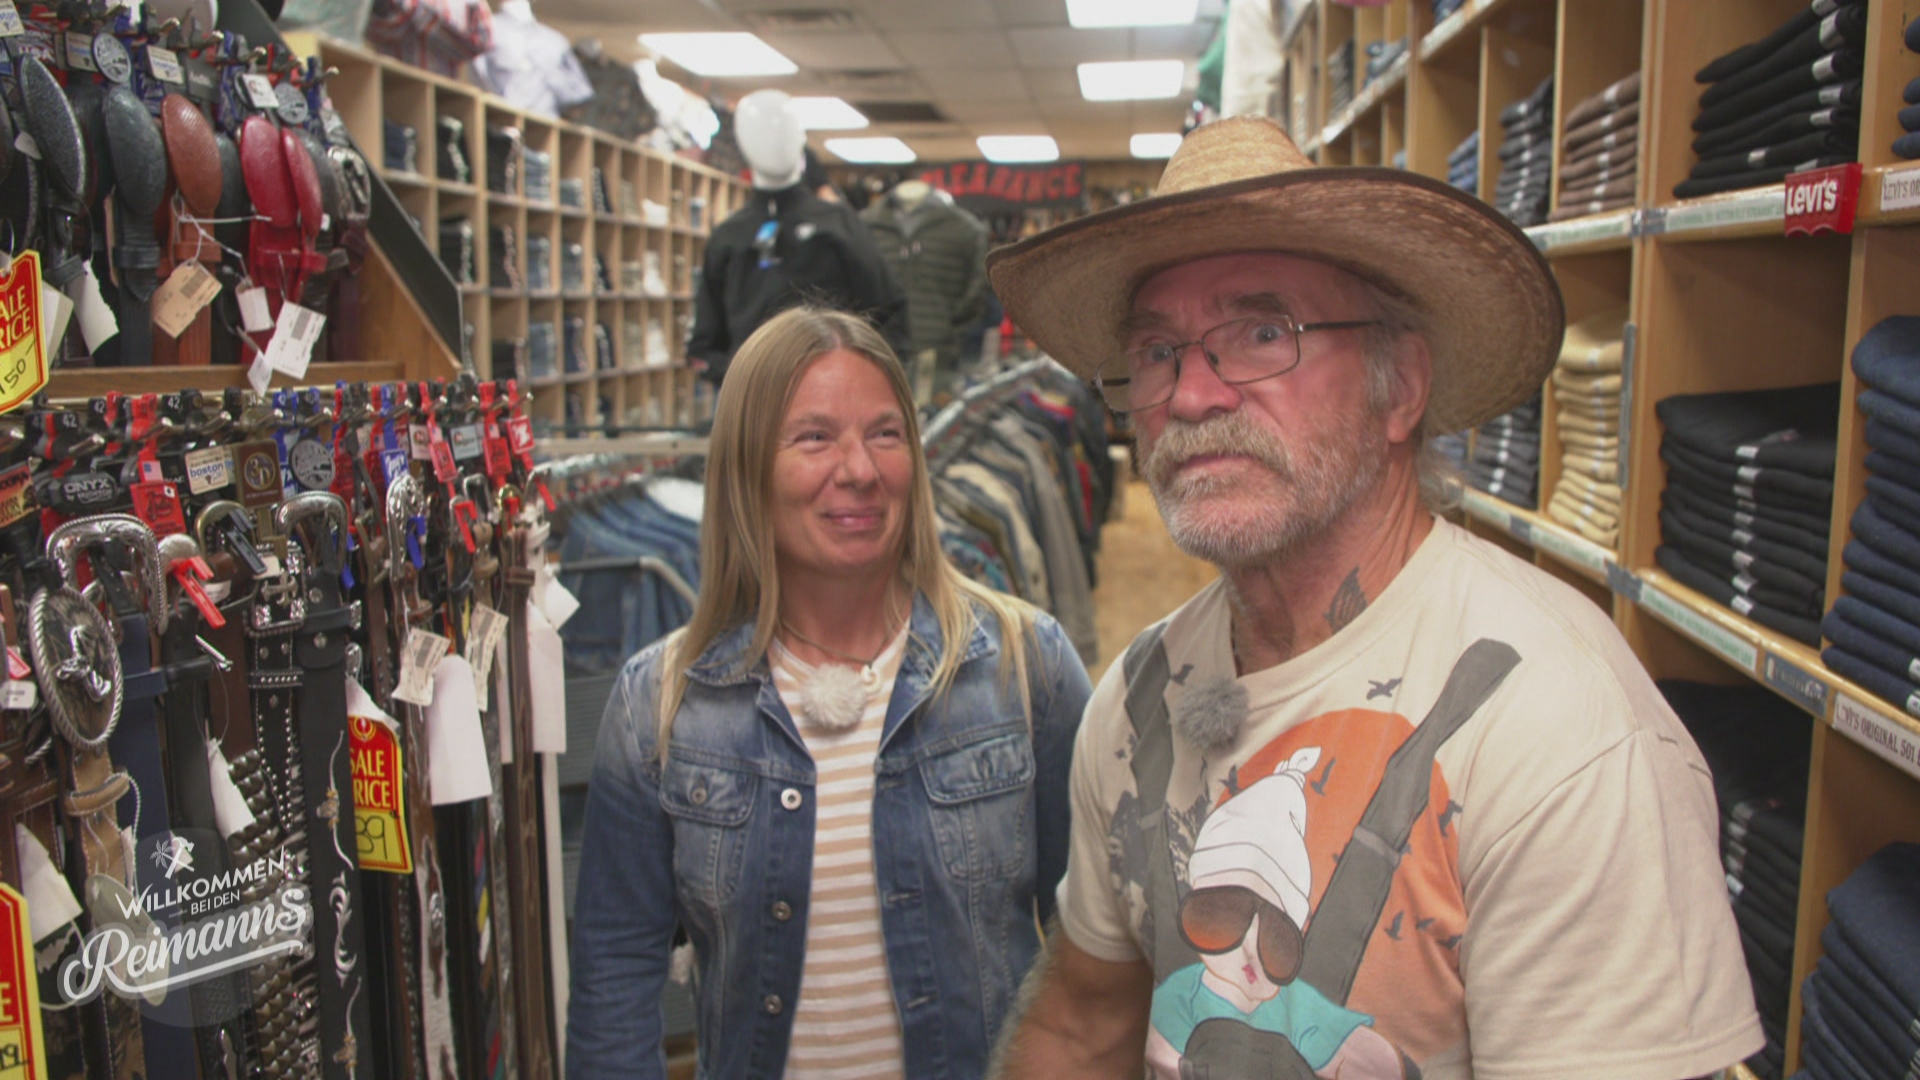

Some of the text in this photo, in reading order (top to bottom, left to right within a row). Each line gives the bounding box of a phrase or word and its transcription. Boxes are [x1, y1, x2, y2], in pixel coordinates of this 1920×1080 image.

[168, 396, 180, 409] 42
[190, 463, 224, 478] boston
[63, 479, 111, 495] ONYX
[1861, 720, 1899, 754] ORIGINAL
[1901, 738, 1915, 763] 501
